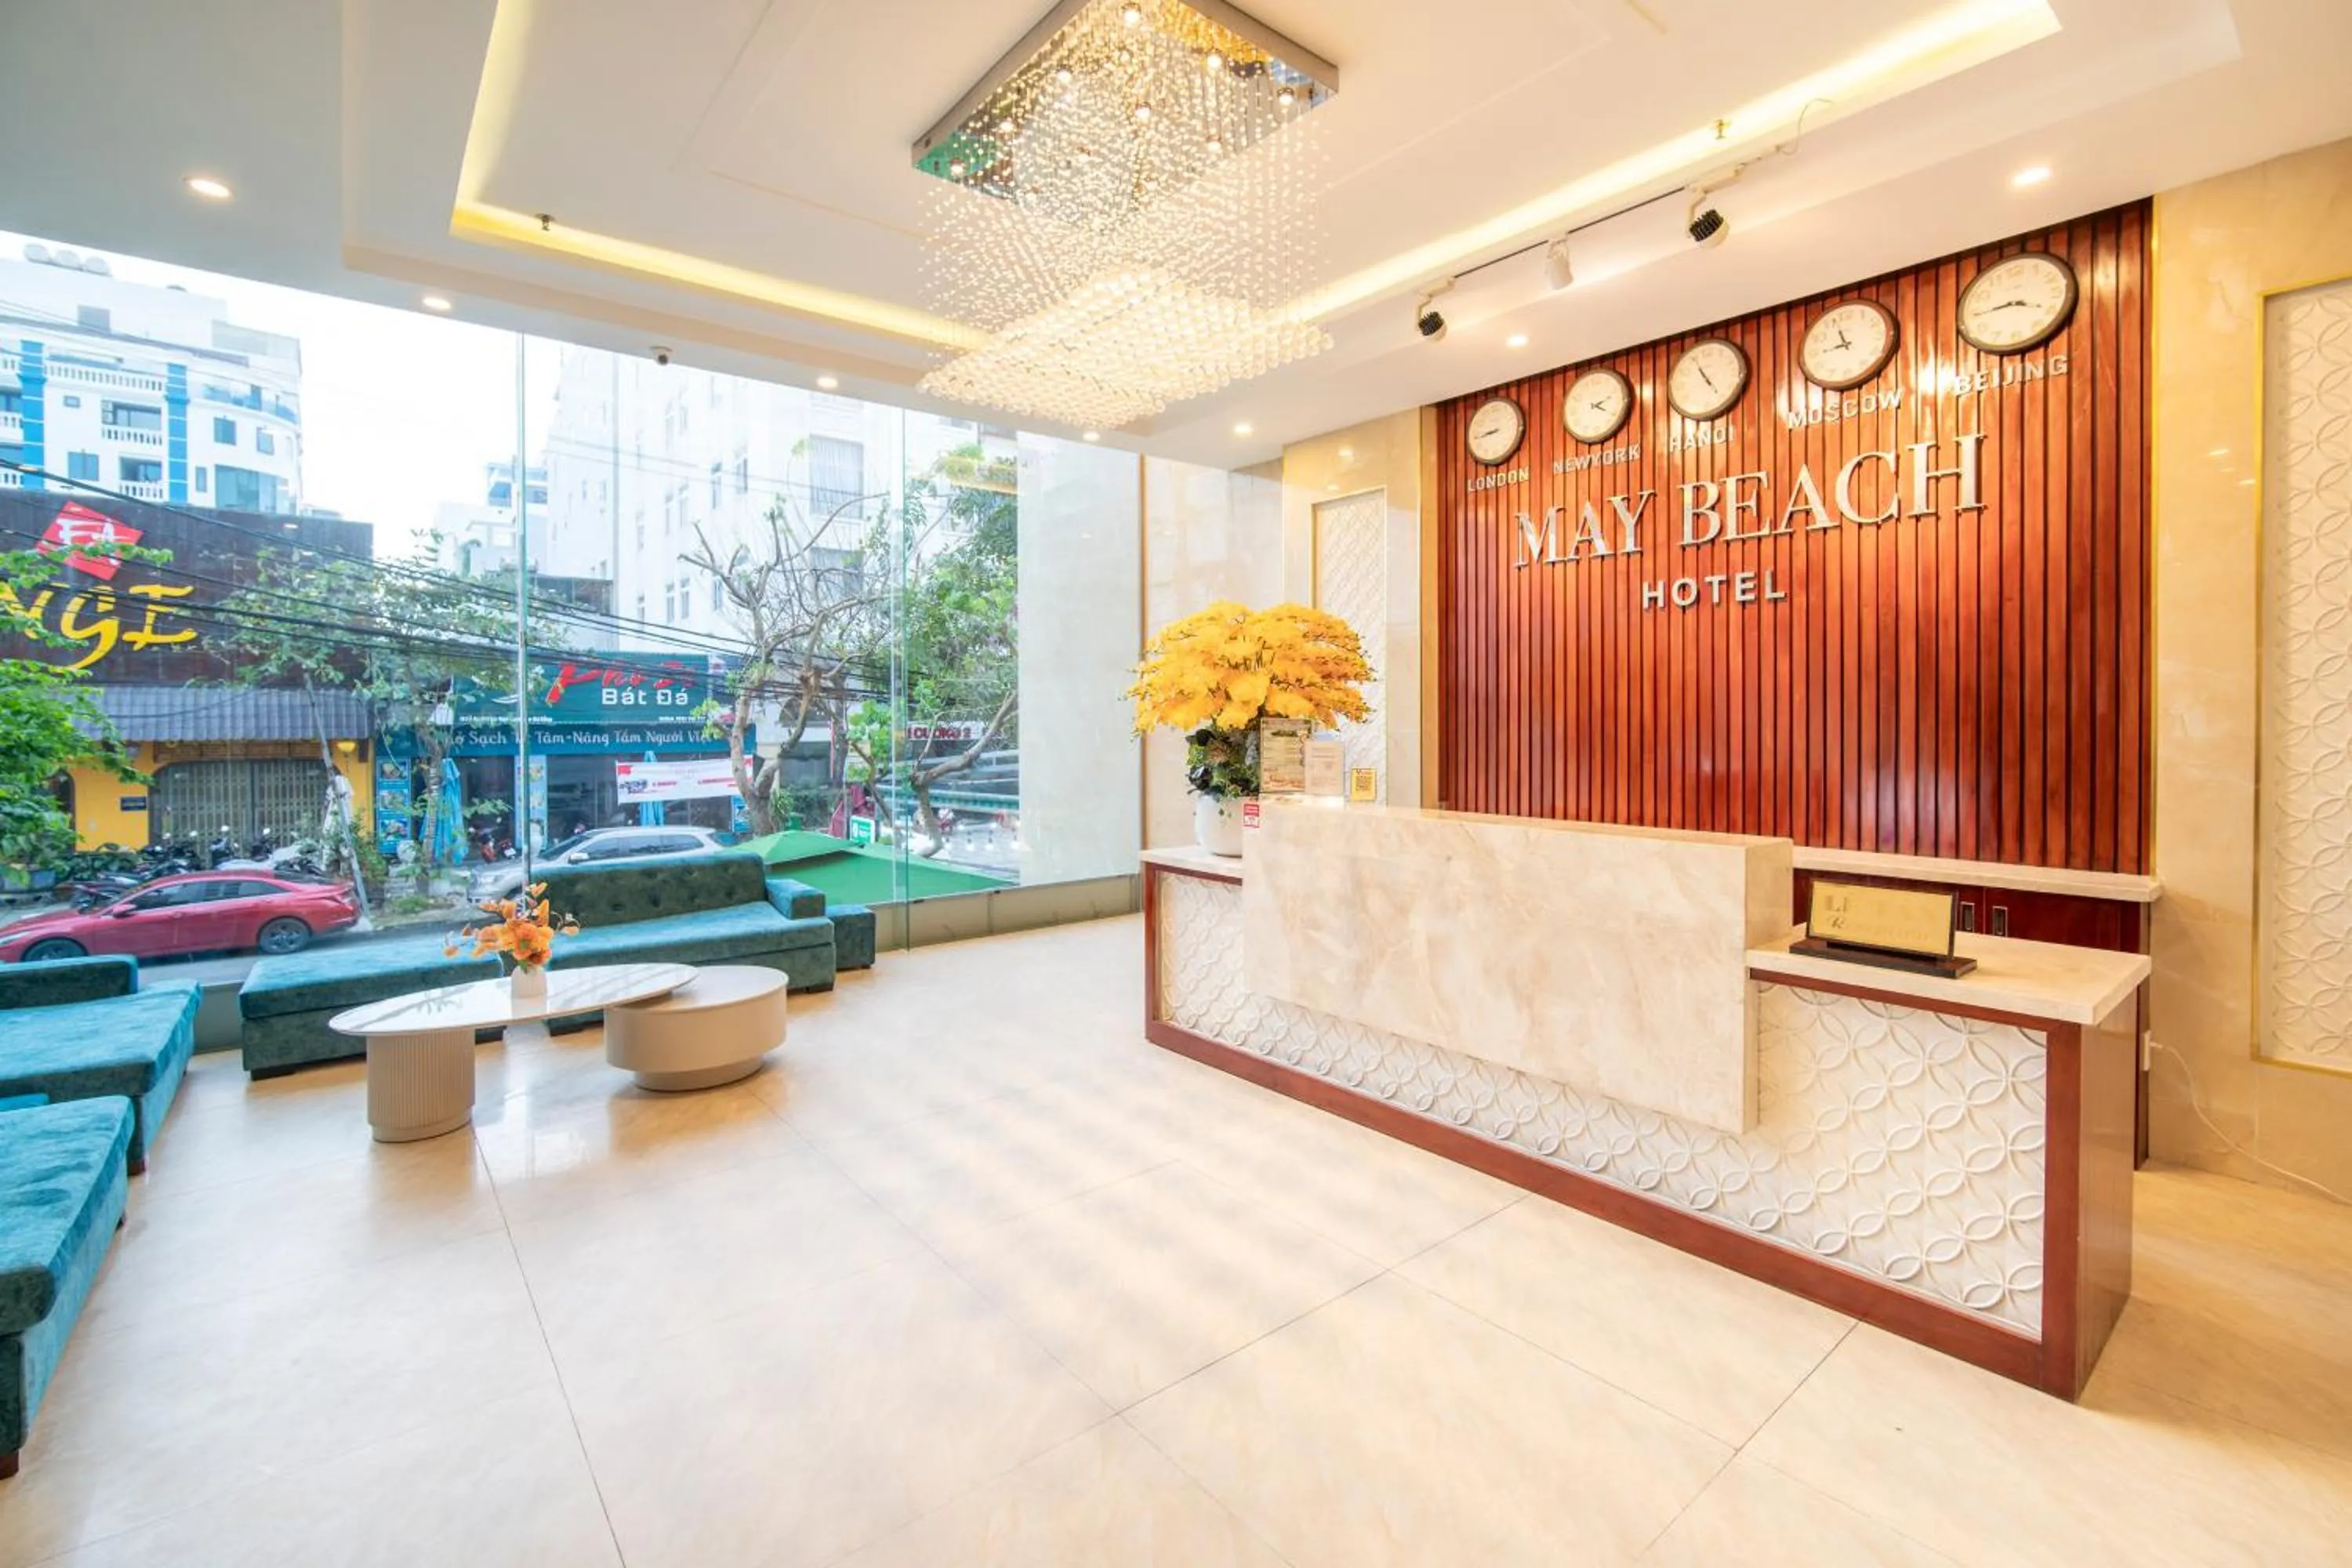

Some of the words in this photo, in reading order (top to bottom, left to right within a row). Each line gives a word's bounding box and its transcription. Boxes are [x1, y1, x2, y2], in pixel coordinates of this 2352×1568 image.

[1955, 354, 2068, 397] BEIJING
[1788, 388, 1904, 430] MOSCOW
[1669, 425, 1735, 453] HANOI
[1552, 443, 1641, 474] NEWYORK
[1467, 466, 1530, 492] LONDON
[1514, 490, 1655, 568] MAY
[1678, 433, 1988, 547] BEACH
[1642, 570, 1786, 609] HOTEL
[601, 687, 647, 706] Bát
